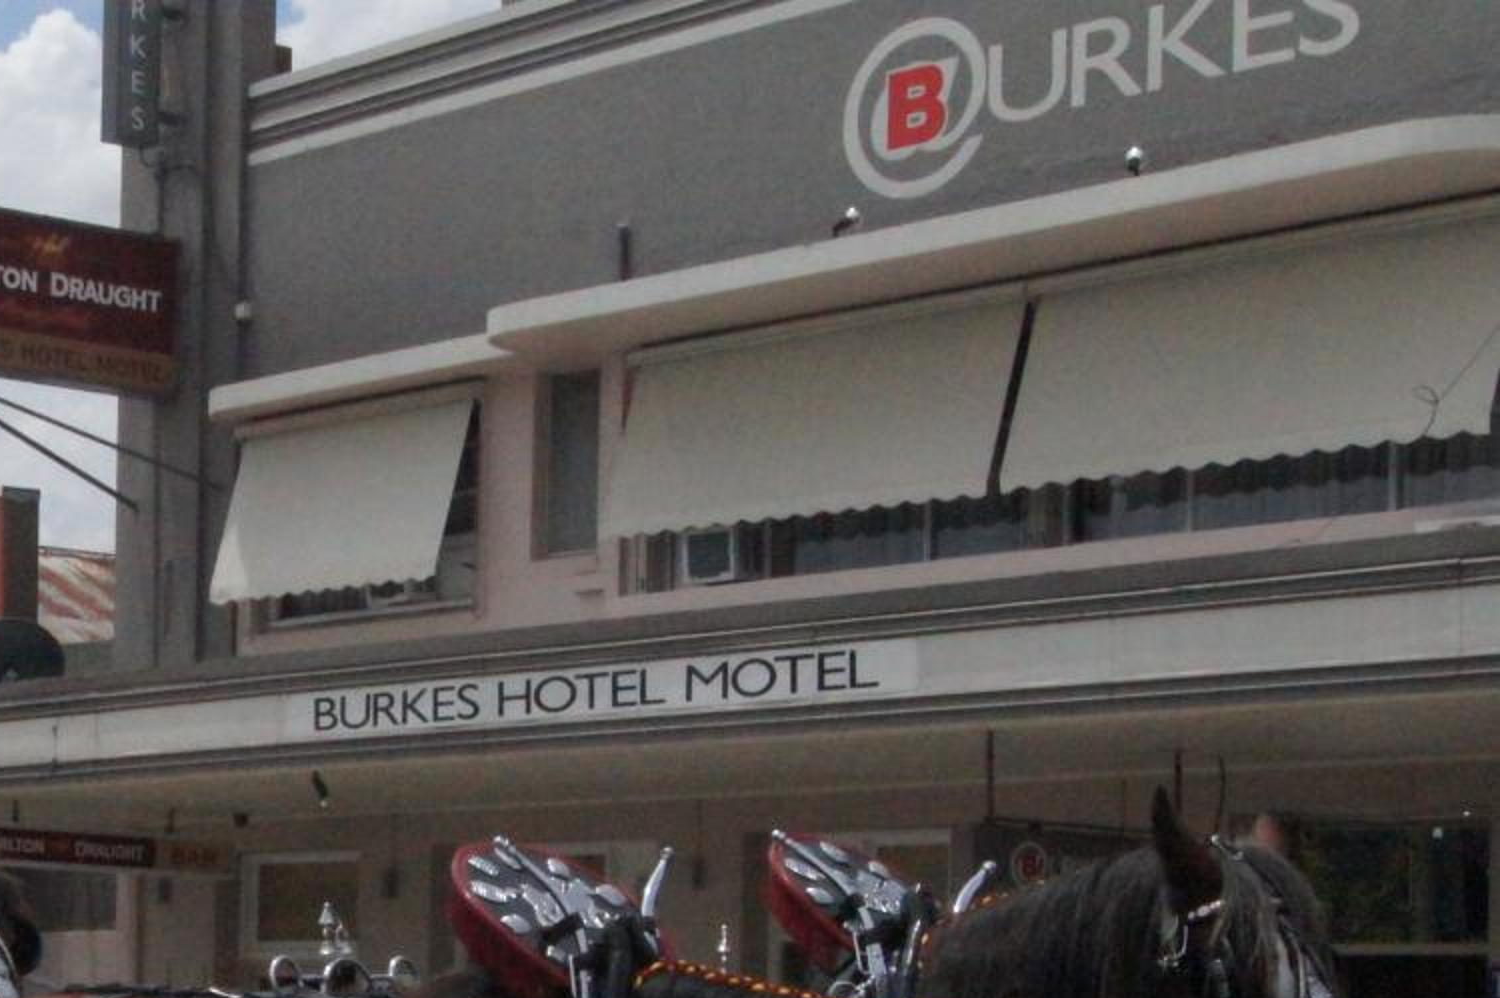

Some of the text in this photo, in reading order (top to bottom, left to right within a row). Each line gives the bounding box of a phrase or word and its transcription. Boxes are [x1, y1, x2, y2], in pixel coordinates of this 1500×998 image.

[843, 0, 1360, 198] BURKES
[50, 272, 163, 313] DRAUGHT
[313, 649, 880, 732] BURKES HOTEL MOTEL
